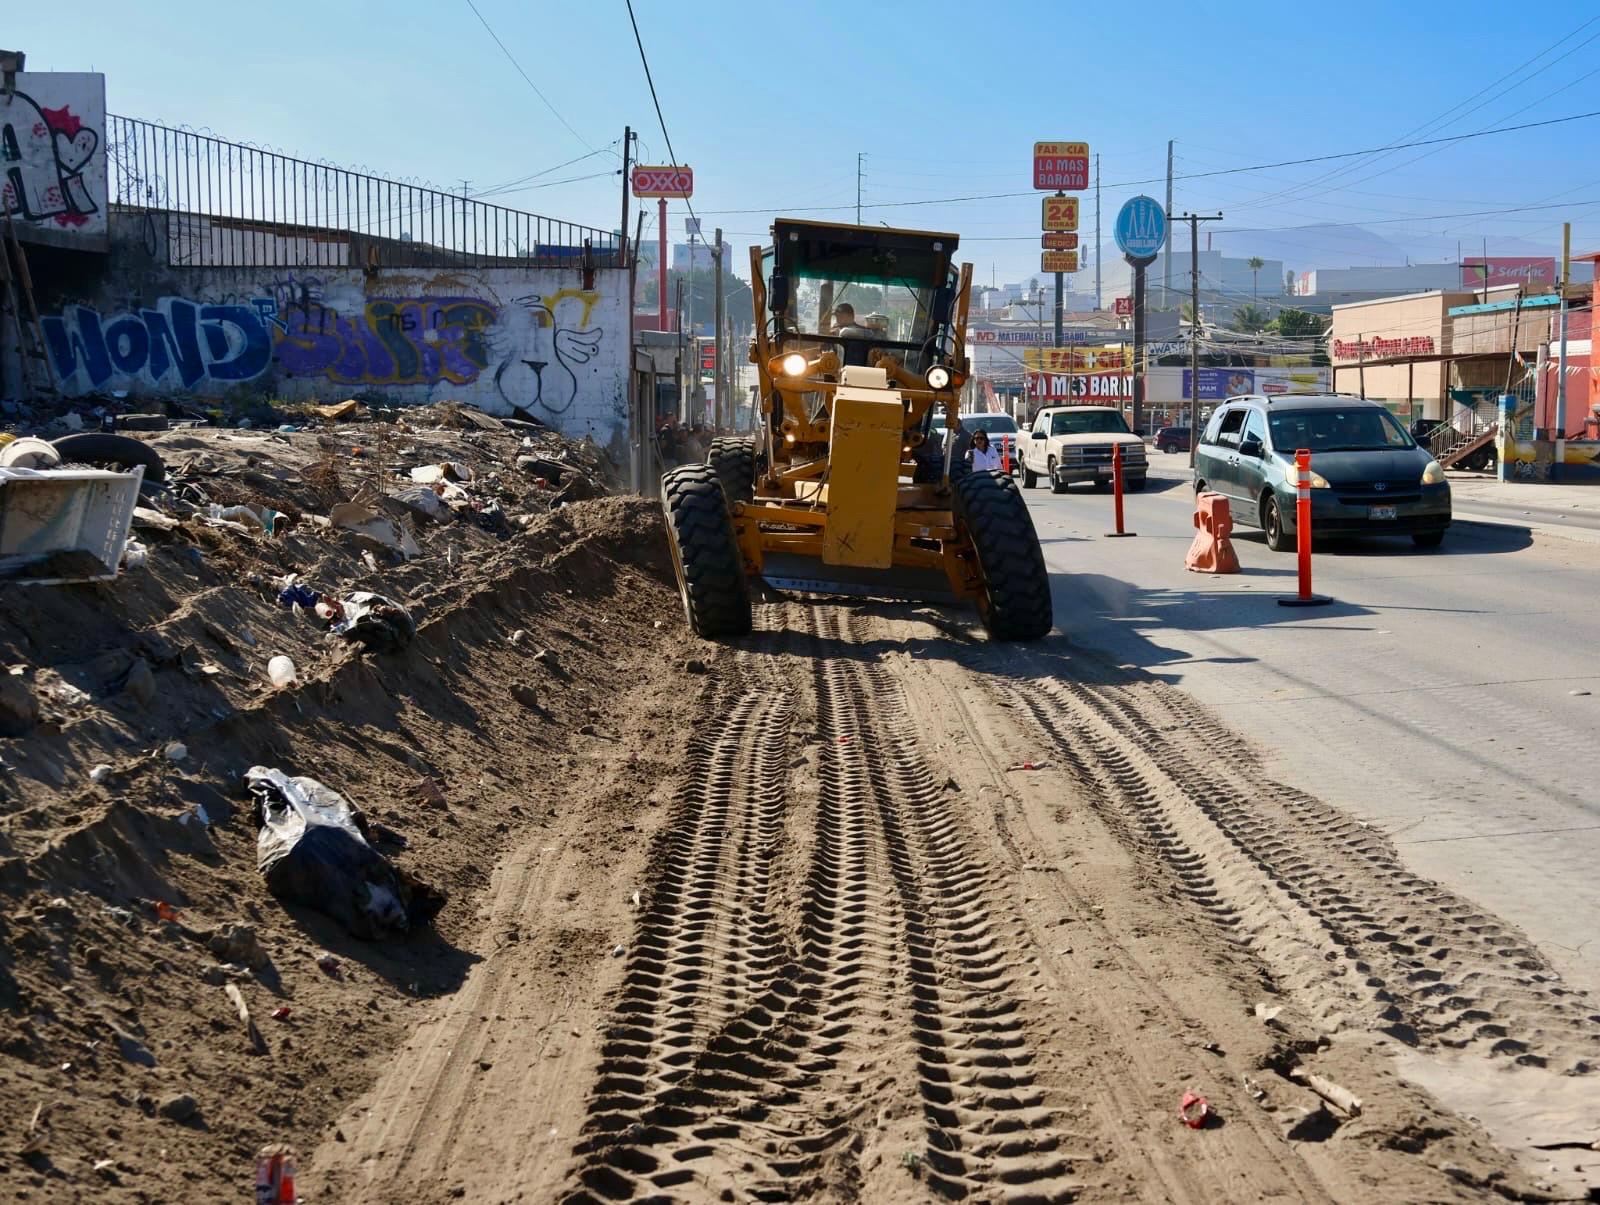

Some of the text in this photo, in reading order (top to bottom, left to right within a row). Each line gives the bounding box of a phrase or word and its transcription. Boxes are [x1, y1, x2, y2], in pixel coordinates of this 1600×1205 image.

[1039, 160, 1084, 172] LA MAS
[635, 173, 690, 191] OXXO
[1039, 174, 1084, 186] BARATA
[1048, 205, 1074, 221] 24
[1090, 375, 1134, 397] BARAT
